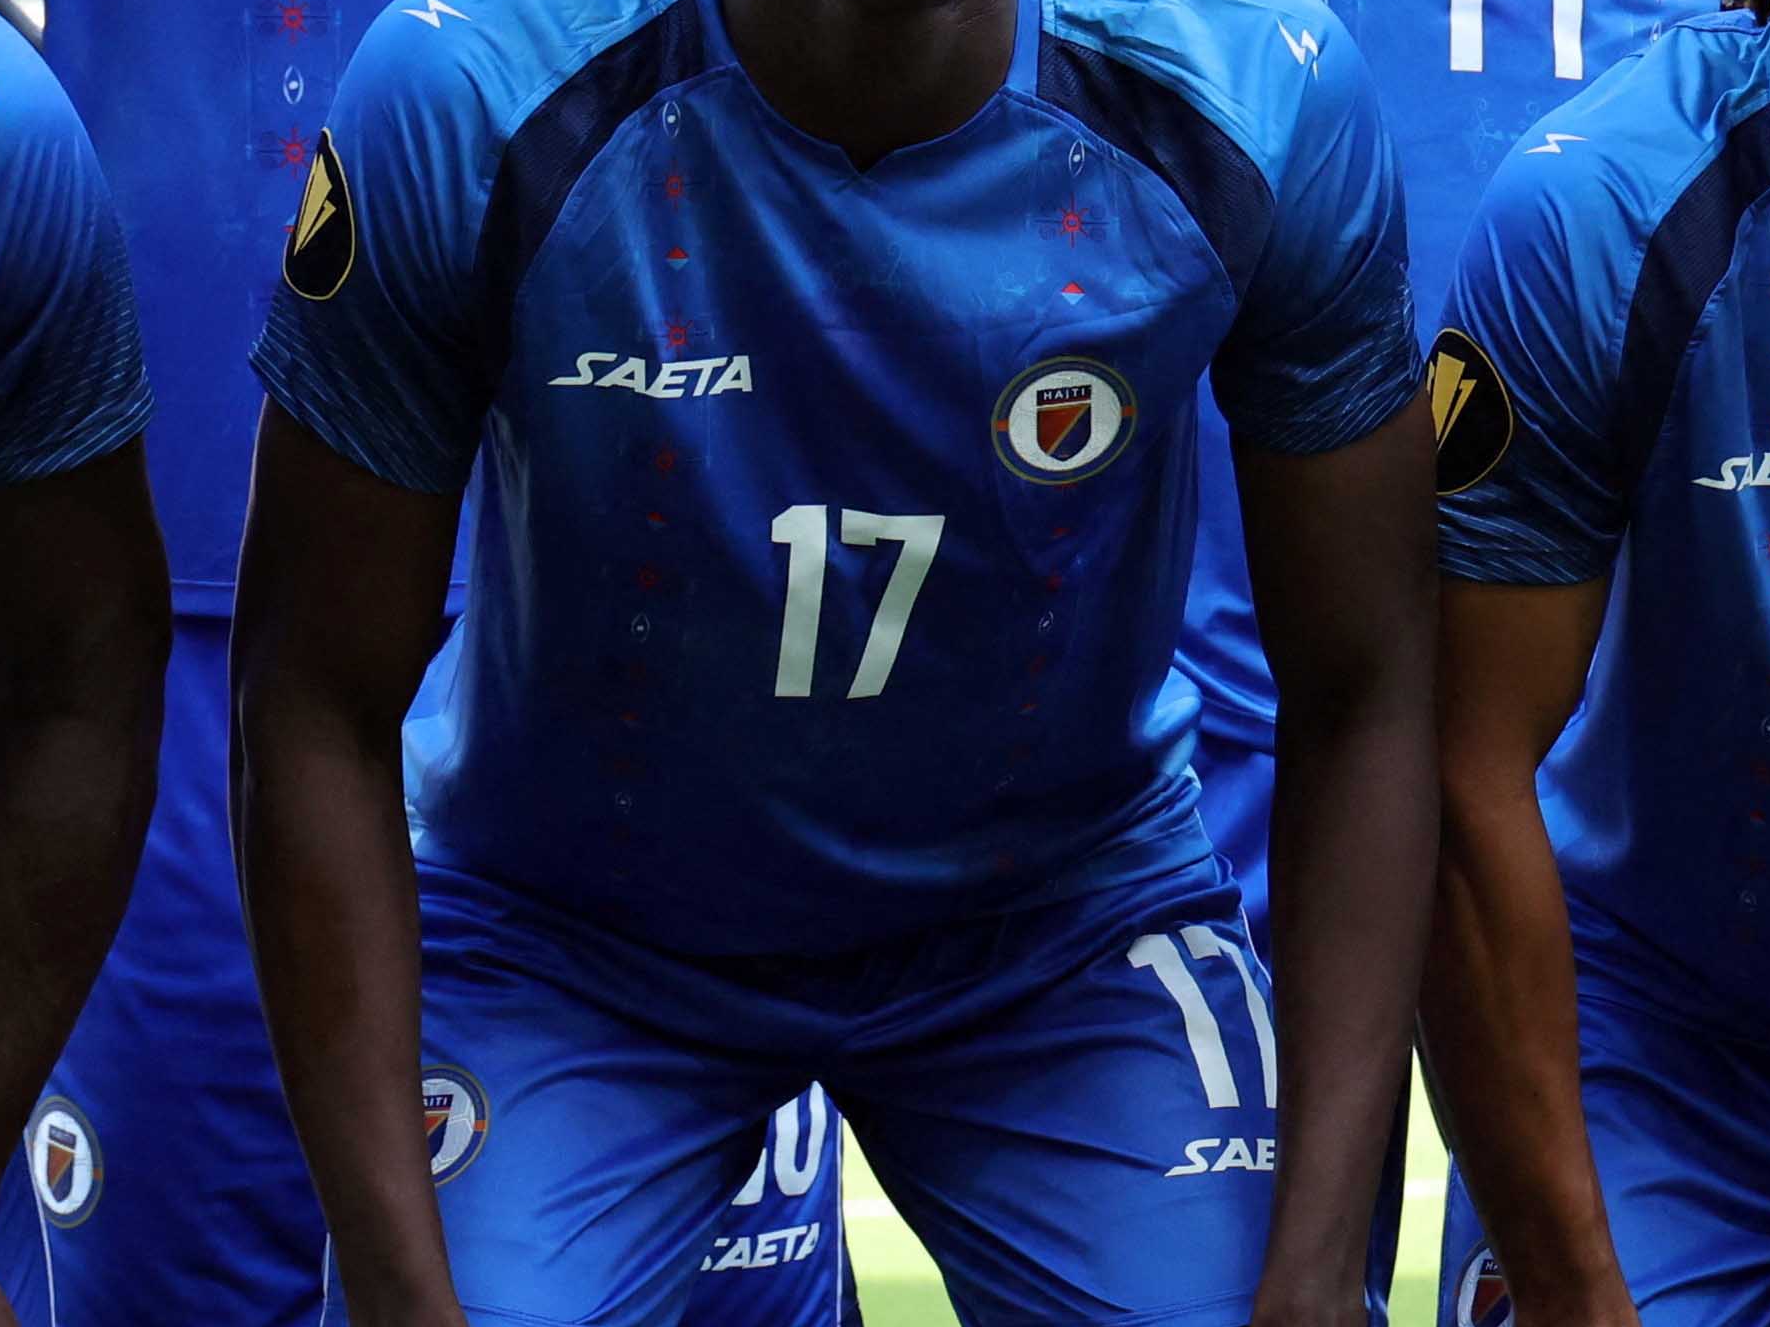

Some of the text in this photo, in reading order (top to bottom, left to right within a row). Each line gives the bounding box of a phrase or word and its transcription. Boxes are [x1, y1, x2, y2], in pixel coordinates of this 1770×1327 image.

[547, 352, 754, 399] SAETA
[1043, 386, 1086, 400] HAITI
[770, 504, 946, 699] 17
[1165, 1137, 1275, 1178] SAE
